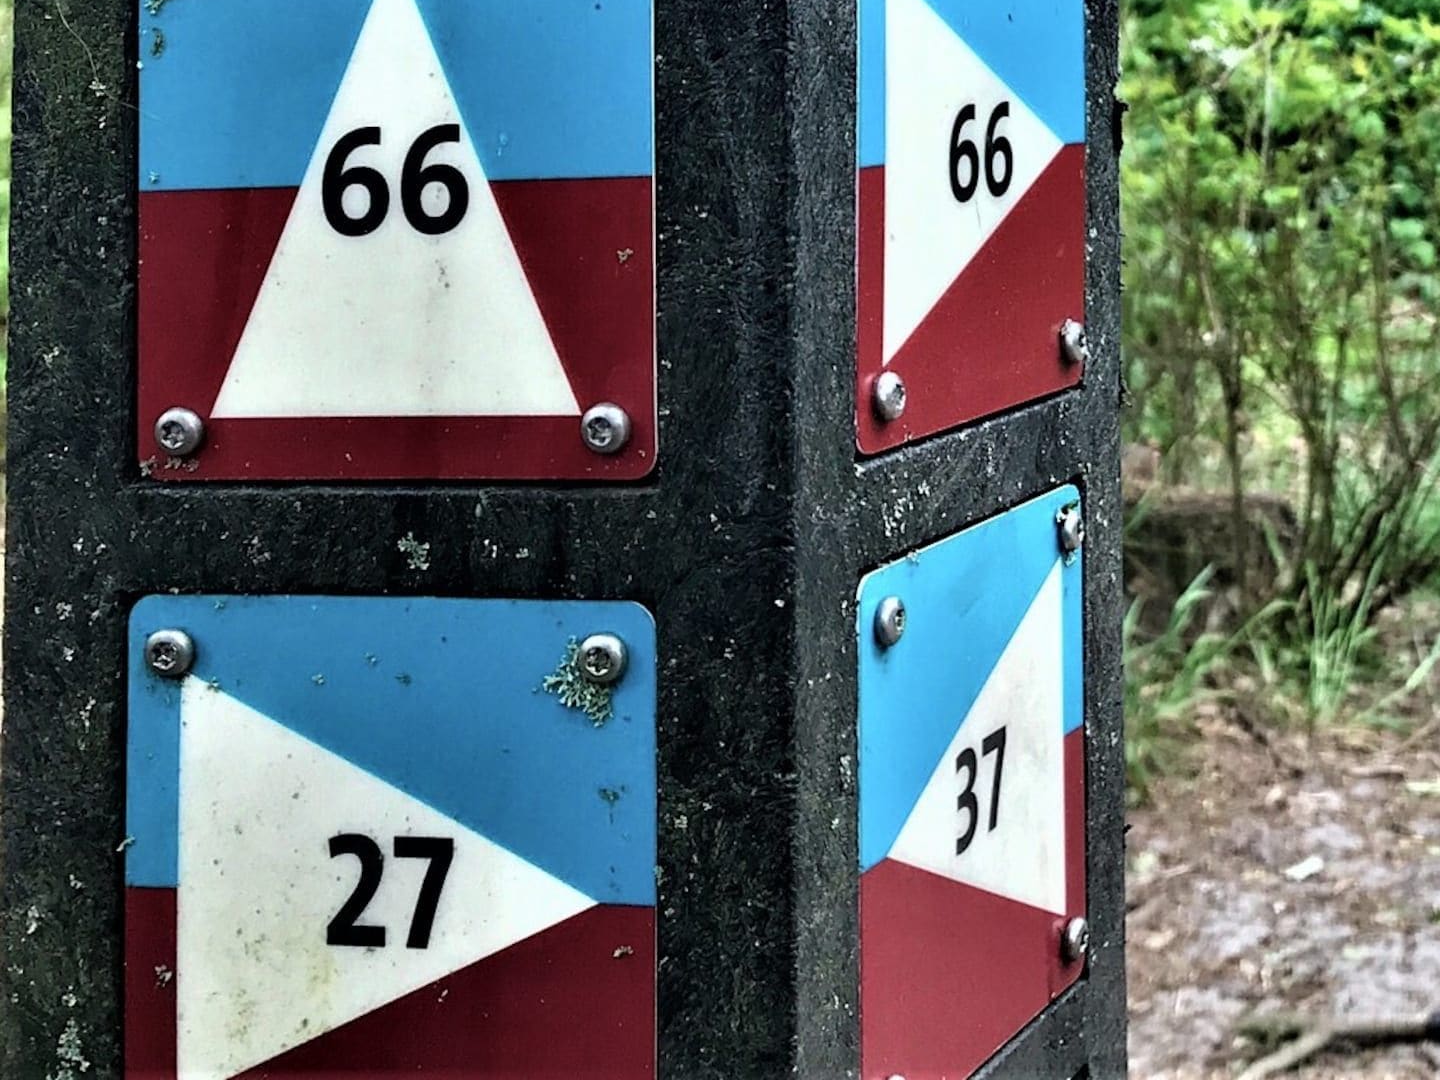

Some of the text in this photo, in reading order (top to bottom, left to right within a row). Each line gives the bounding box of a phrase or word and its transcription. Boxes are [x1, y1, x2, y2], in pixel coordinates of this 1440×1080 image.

[321, 123, 469, 237] 66
[948, 100, 1014, 204] 66
[953, 727, 1010, 856] 37
[325, 833, 455, 950] 27
